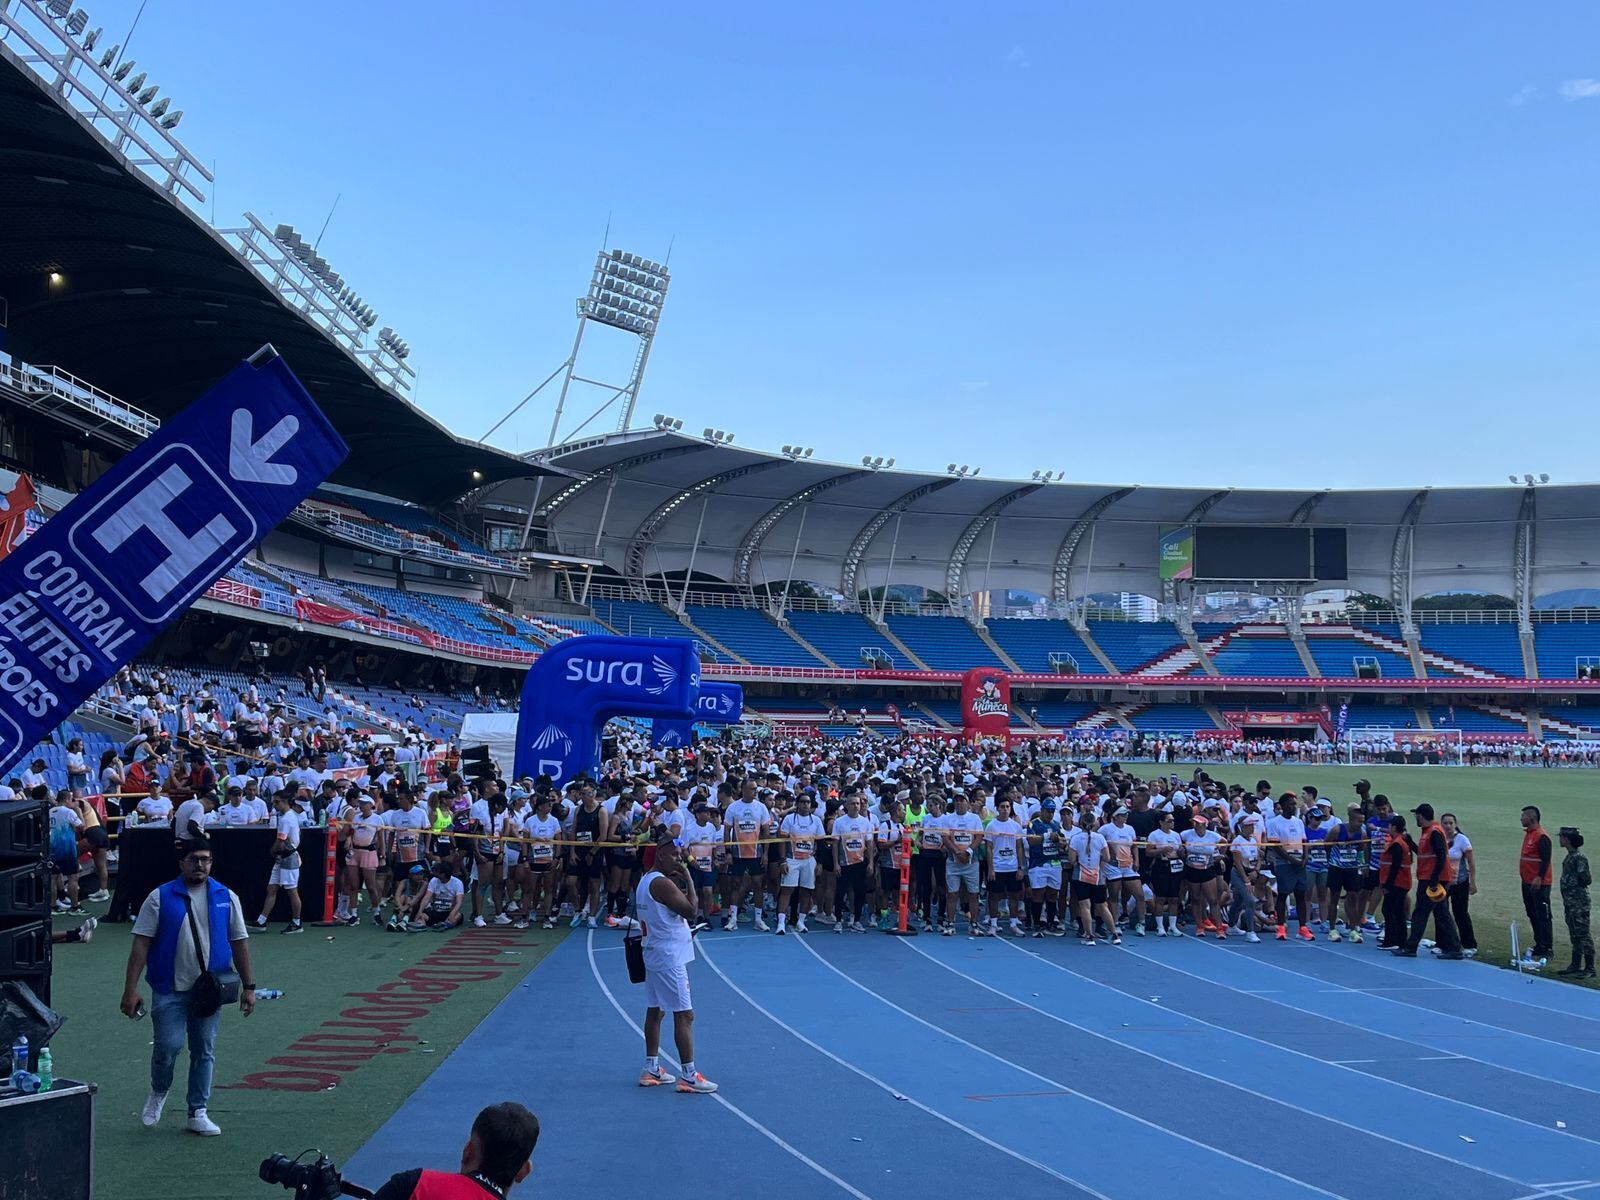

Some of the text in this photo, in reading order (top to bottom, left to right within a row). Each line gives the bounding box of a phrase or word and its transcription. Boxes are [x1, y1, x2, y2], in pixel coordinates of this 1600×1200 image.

[91, 462, 237, 603] H
[1163, 543, 1179, 551] Cali
[0, 589, 93, 684] ÉLITES
[23, 550, 136, 662] CORRAL
[0, 635, 59, 718] ROES
[566, 657, 643, 686] sura
[698, 696, 717, 710] ra
